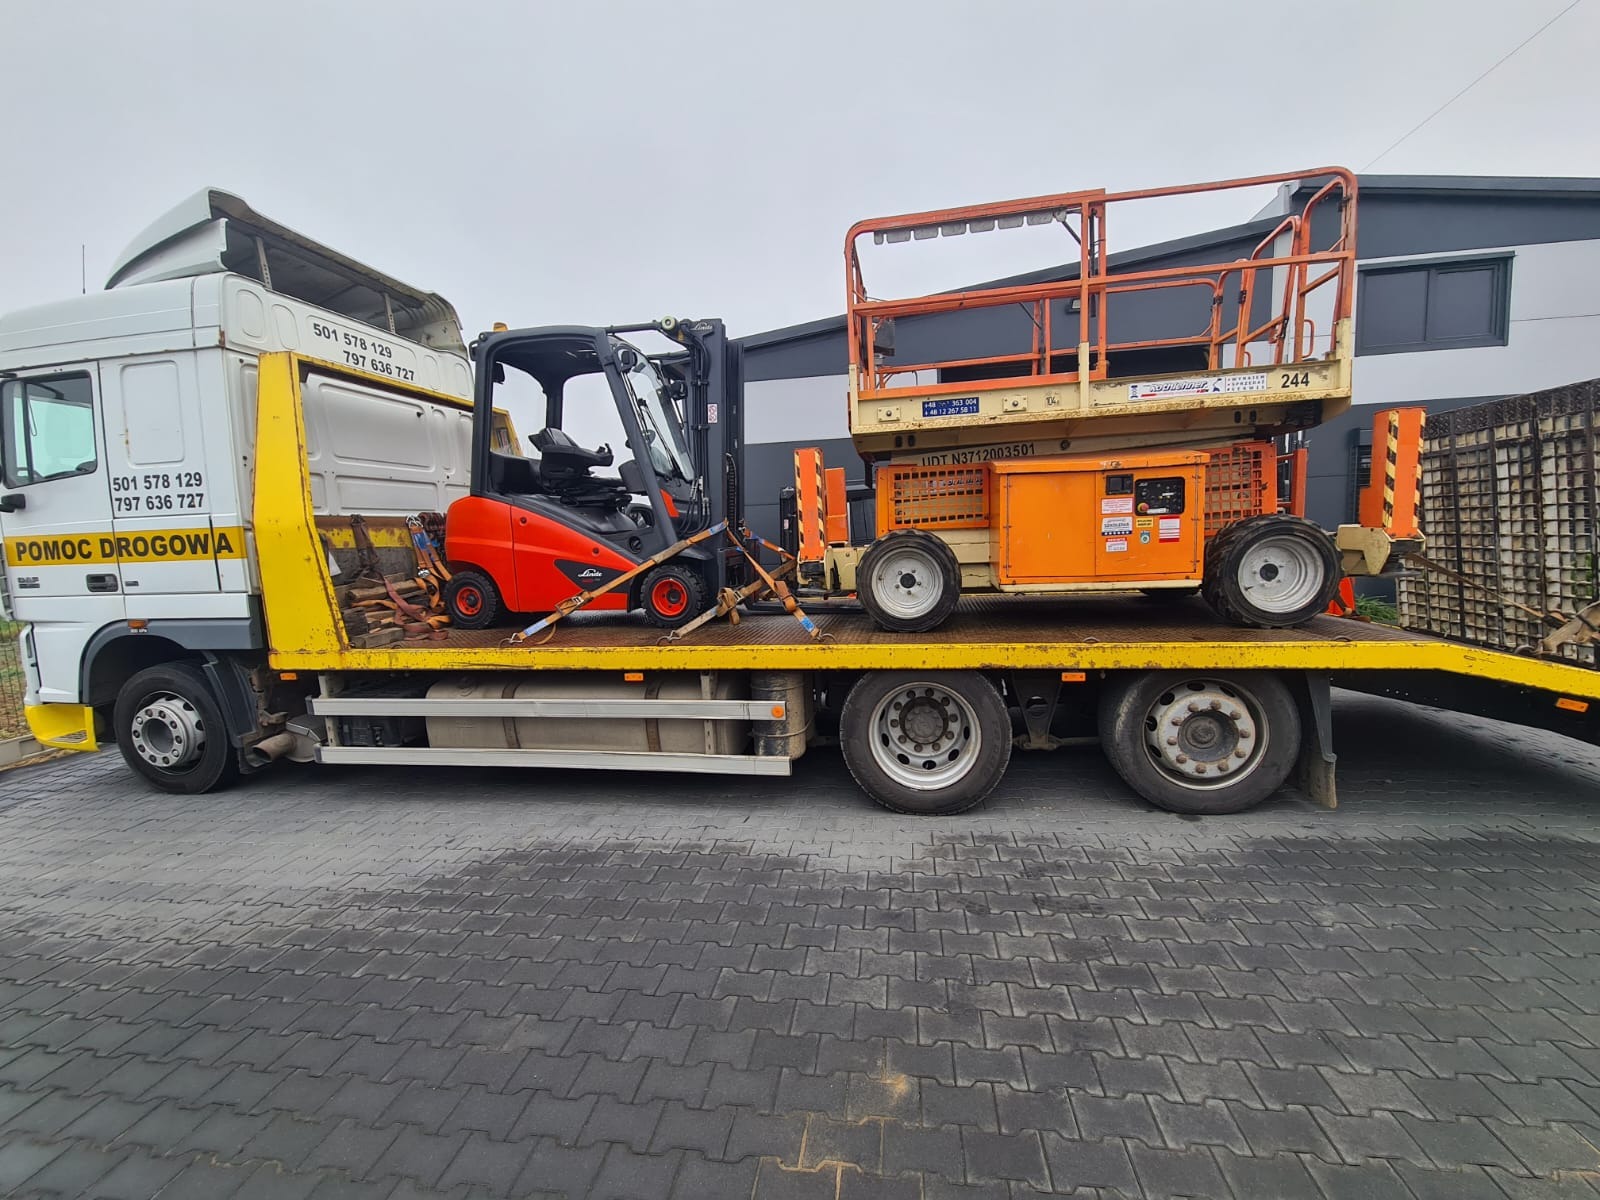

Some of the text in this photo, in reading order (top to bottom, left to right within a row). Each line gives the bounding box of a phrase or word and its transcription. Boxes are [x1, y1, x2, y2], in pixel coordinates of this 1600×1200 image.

[313, 322, 392, 358] 501 578 129
[343, 350, 415, 381] 797 636 727
[1281, 372, 1310, 389] 244
[922, 442, 1035, 466] UDT N3712003501
[112, 471, 203, 492] 501 578 129
[115, 493, 204, 512] 797 636 727
[16, 532, 234, 562] POMOC DROGOWA
[578, 568, 603, 577] Linde
